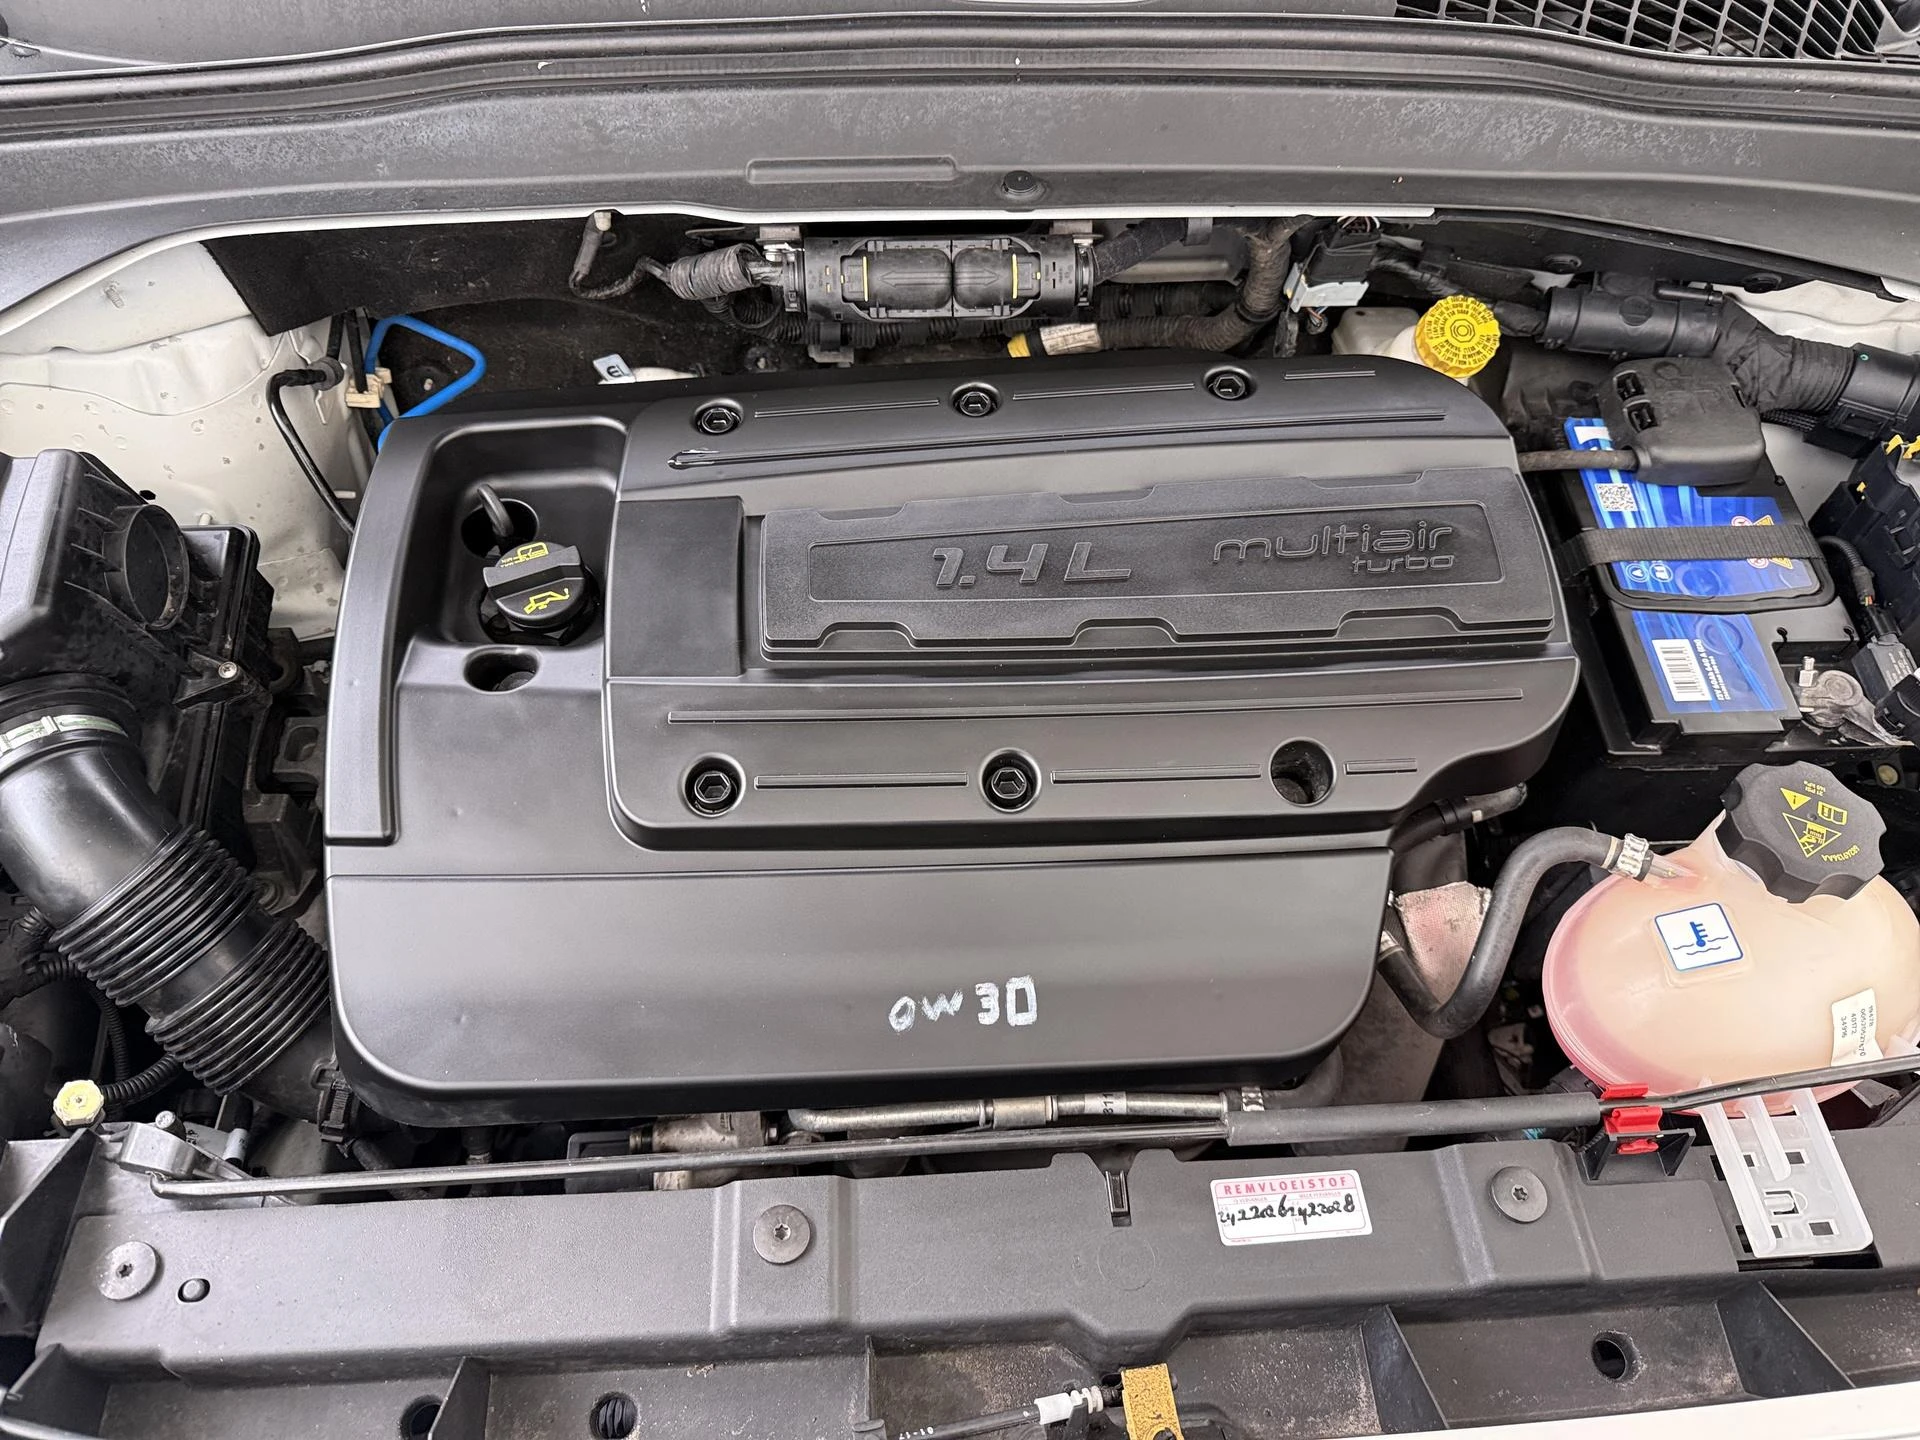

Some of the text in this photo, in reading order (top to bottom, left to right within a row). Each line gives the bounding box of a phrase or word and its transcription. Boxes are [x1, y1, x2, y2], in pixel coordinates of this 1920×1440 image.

[933, 520, 1454, 587] 1.4 L multiair
[1351, 553, 1456, 574] turbo
[1223, 1176, 1348, 1195] REMVLOEISTOF
